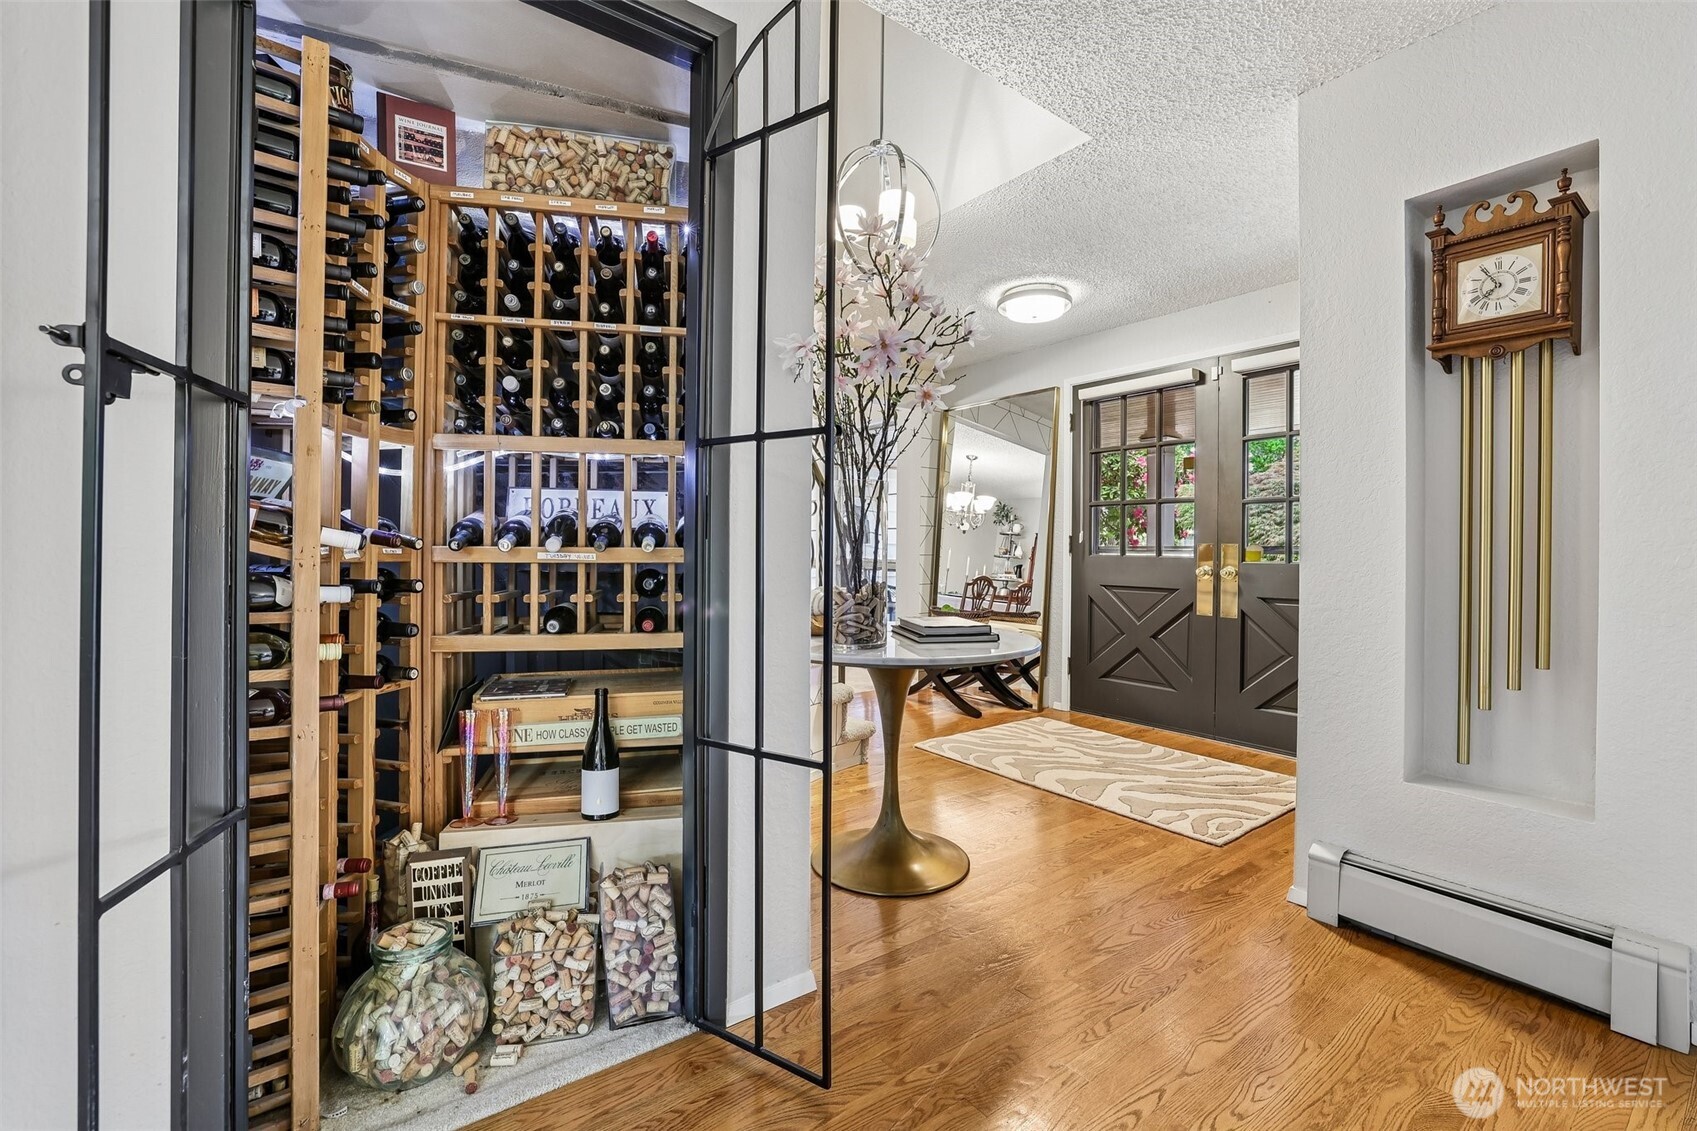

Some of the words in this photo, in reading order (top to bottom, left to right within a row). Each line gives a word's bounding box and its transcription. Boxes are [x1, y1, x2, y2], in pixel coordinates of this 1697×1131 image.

[399, 117, 415, 125] WINE
[416, 121, 443, 132] JOURNAL
[536, 729, 557, 740] HOW
[558, 727, 591, 739] CLASSY
[626, 724, 643, 735] GET
[644, 722, 678, 734] WASTED
[415, 862, 462, 883] COFFEE
[421, 883, 456, 901] UNTIL
[515, 879, 547, 889] MERLOT
[521, 892, 539, 901] 1875
[427, 902, 452, 919] IT'S
